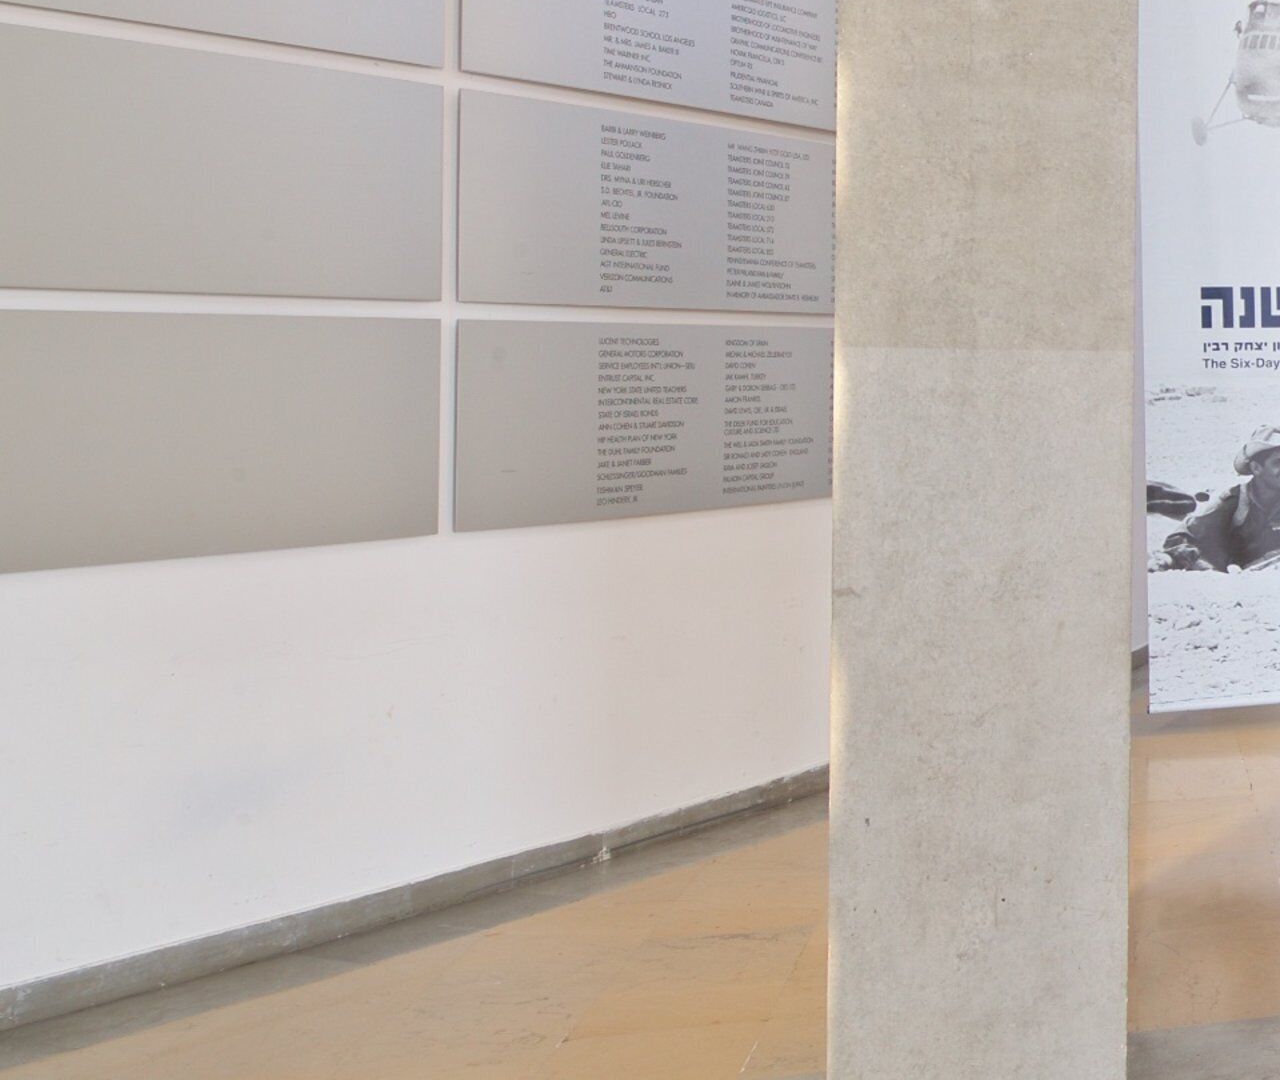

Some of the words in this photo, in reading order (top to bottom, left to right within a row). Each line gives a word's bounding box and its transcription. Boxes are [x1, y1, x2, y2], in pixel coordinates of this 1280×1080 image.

[638, 4, 655, 15] LOCAL
[603, 21, 638, 36] BRENTWOOD
[640, 28, 661, 40] SCHOOL
[673, 35, 695, 47] ANGELES
[634, 40, 651, 50] JAMES
[617, 49, 639, 60] WARNER
[614, 61, 646, 73] AHMANSON
[648, 67, 681, 80] FOUNDATION
[603, 71, 627, 82] STEWART
[633, 76, 650, 86] LYNDA
[754, 97, 772, 107] CANADA
[601, 136, 617, 145] LESTER
[615, 150, 650, 162] GOLDENBERG
[612, 211, 630, 221] LEVINE
[630, 225, 666, 236] CORPORATION
[600, 247, 623, 256] GENERAL
[625, 249, 647, 258] ELECTRIC
[600, 271, 623, 281] VERIZON
[625, 273, 672, 285] COMMUNICATIONS
[1203, 342, 1229, 353] רבין
[1234, 341, 1267, 352] יצחק
[1203, 358, 1227, 369] The
[1230, 357, 1280, 371] Six-Day
[598, 374, 620, 382] ENTRUST
